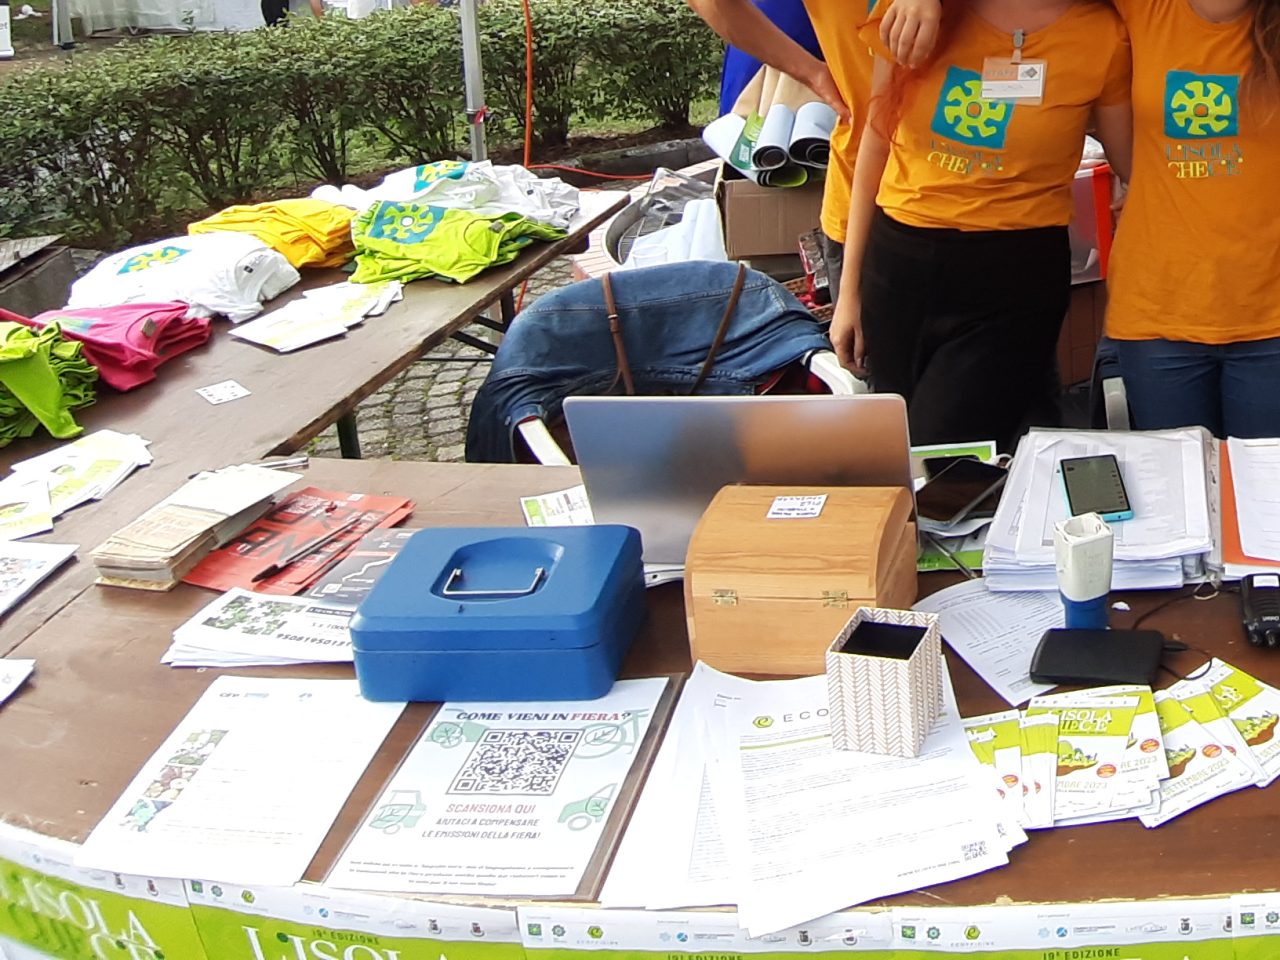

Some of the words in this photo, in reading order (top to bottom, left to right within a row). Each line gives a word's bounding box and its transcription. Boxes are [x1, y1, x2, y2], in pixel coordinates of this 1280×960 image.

[927, 151, 969, 174] CHE
[1168, 160, 1209, 179] CHE
[456, 712, 504, 721] COME
[507, 713, 550, 721] VIENI
[551, 713, 568, 721] IN
[569, 712, 632, 722] FIERA?
[446, 804, 513, 814] SCANSIONA
[515, 804, 536, 814] QUI
[479, 818, 540, 827] COMPENSARE
[422, 831, 433, 839] LE
[434, 831, 480, 839] EMISSIONI
[482, 831, 510, 839] DELLA
[1065, 947, 1121, 960] EDIZIONE
